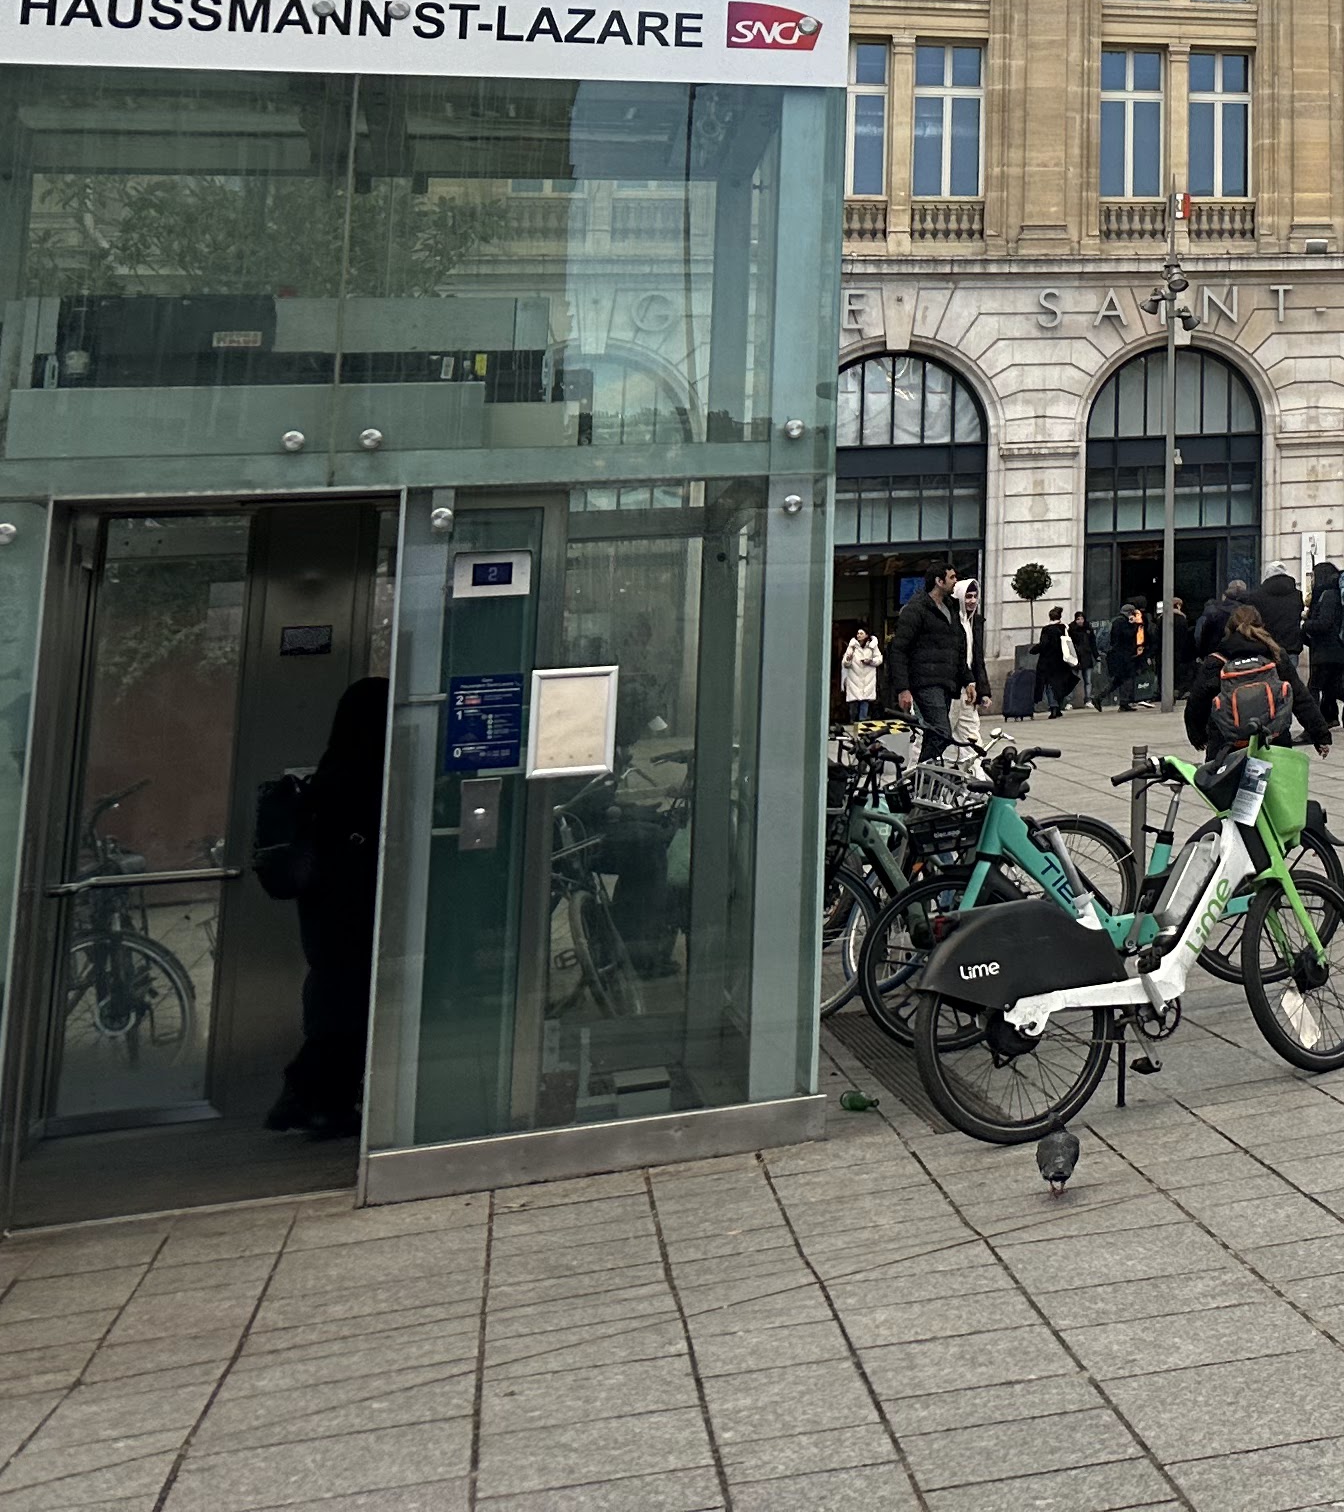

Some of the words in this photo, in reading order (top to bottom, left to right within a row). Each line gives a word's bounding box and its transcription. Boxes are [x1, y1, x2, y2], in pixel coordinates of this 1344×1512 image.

[412, 0, 704, 49] ST-LAZARE
[488, 566, 498, 582] 2
[456, 695, 464, 706] 2
[456, 710, 463, 721] 1
[1040, 855, 1075, 904] TIE
[1184, 878, 1232, 954] Lime
[959, 961, 1000, 981] Lime
